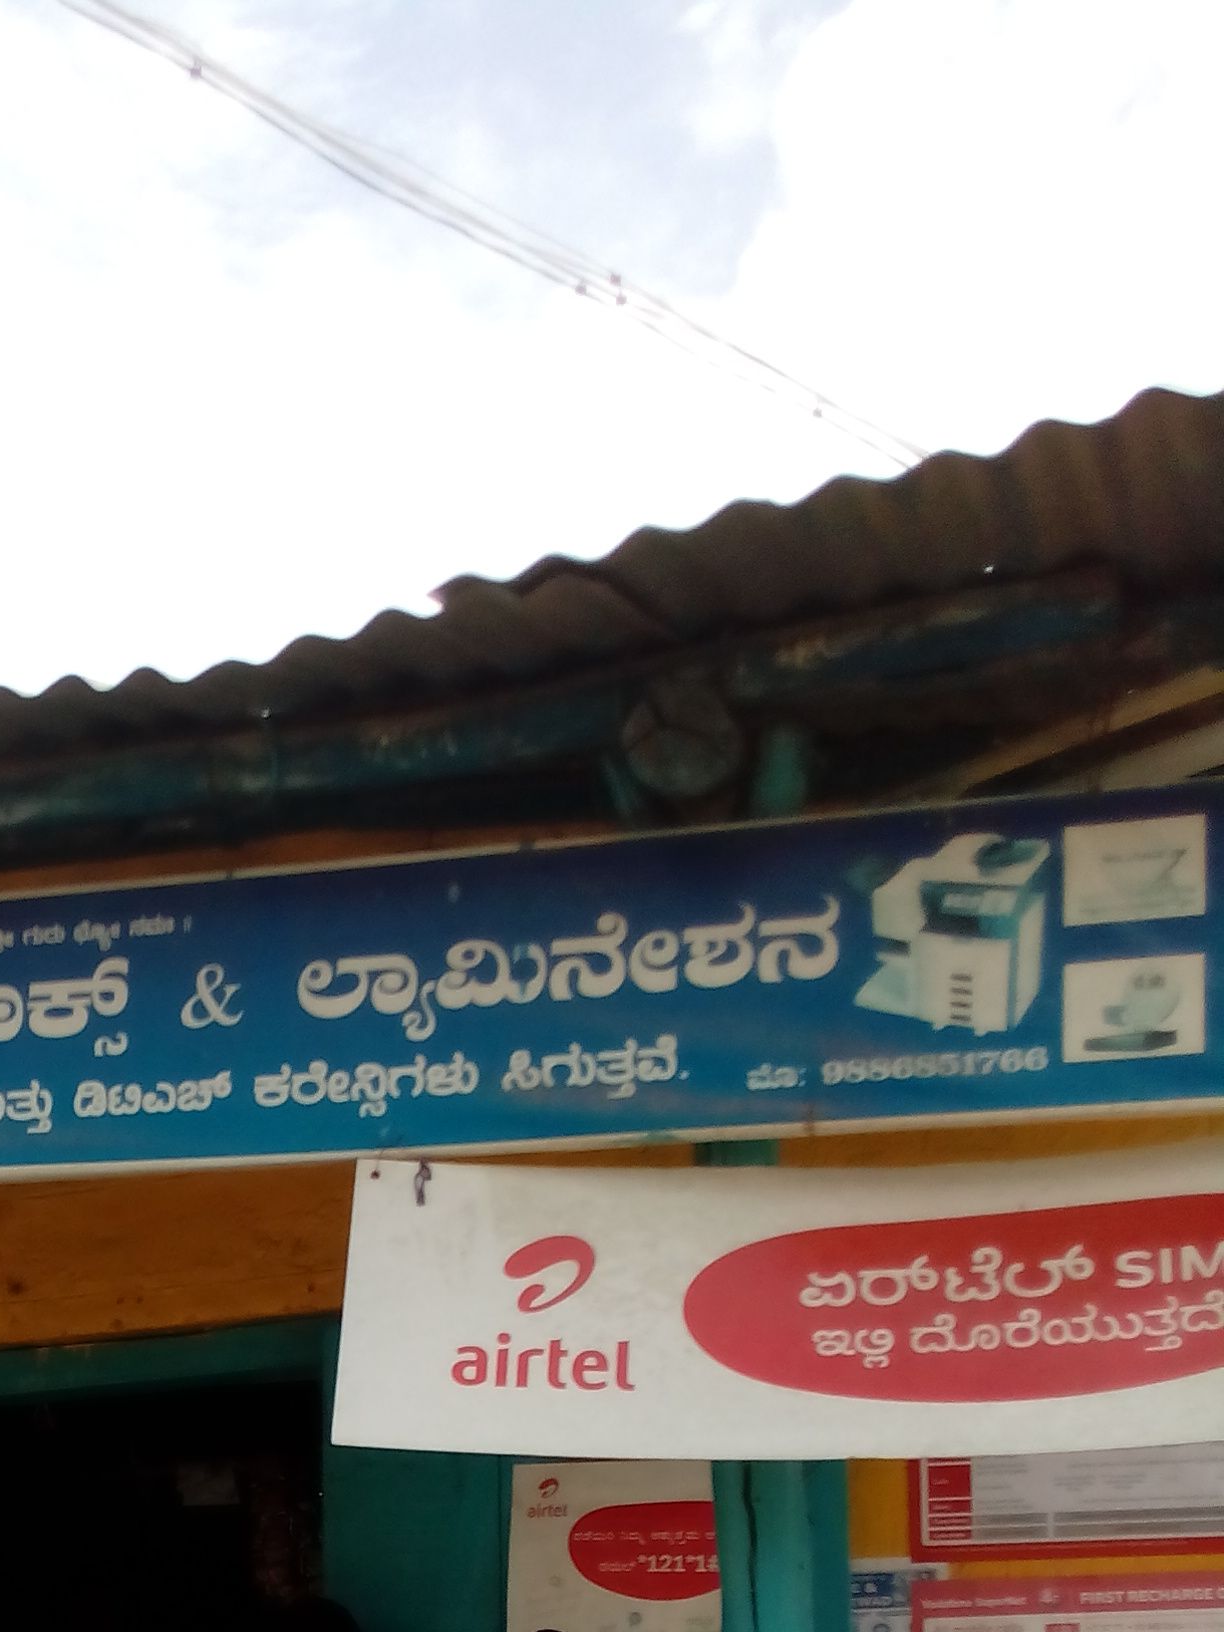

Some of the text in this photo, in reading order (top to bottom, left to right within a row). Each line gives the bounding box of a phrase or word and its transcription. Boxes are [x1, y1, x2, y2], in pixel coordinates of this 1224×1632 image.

[180, 962, 244, 1029] &
[297, 896, 840, 1042] ಲ್ಯಾಮಿನೇಶನ
[74, 1070, 232, 1118] ಡಿಟಿಎಚ್
[1115, 1241, 1224, 1289] SIM
[451, 1332, 635, 1391] airtel
[812, 1327, 895, 1369] ಇಲ್ಲಿ
[527, 1503, 569, 1520] airtel
[1079, 1591, 1125, 1605] FIRST
[1127, 1587, 1214, 1603] RECHARGE
